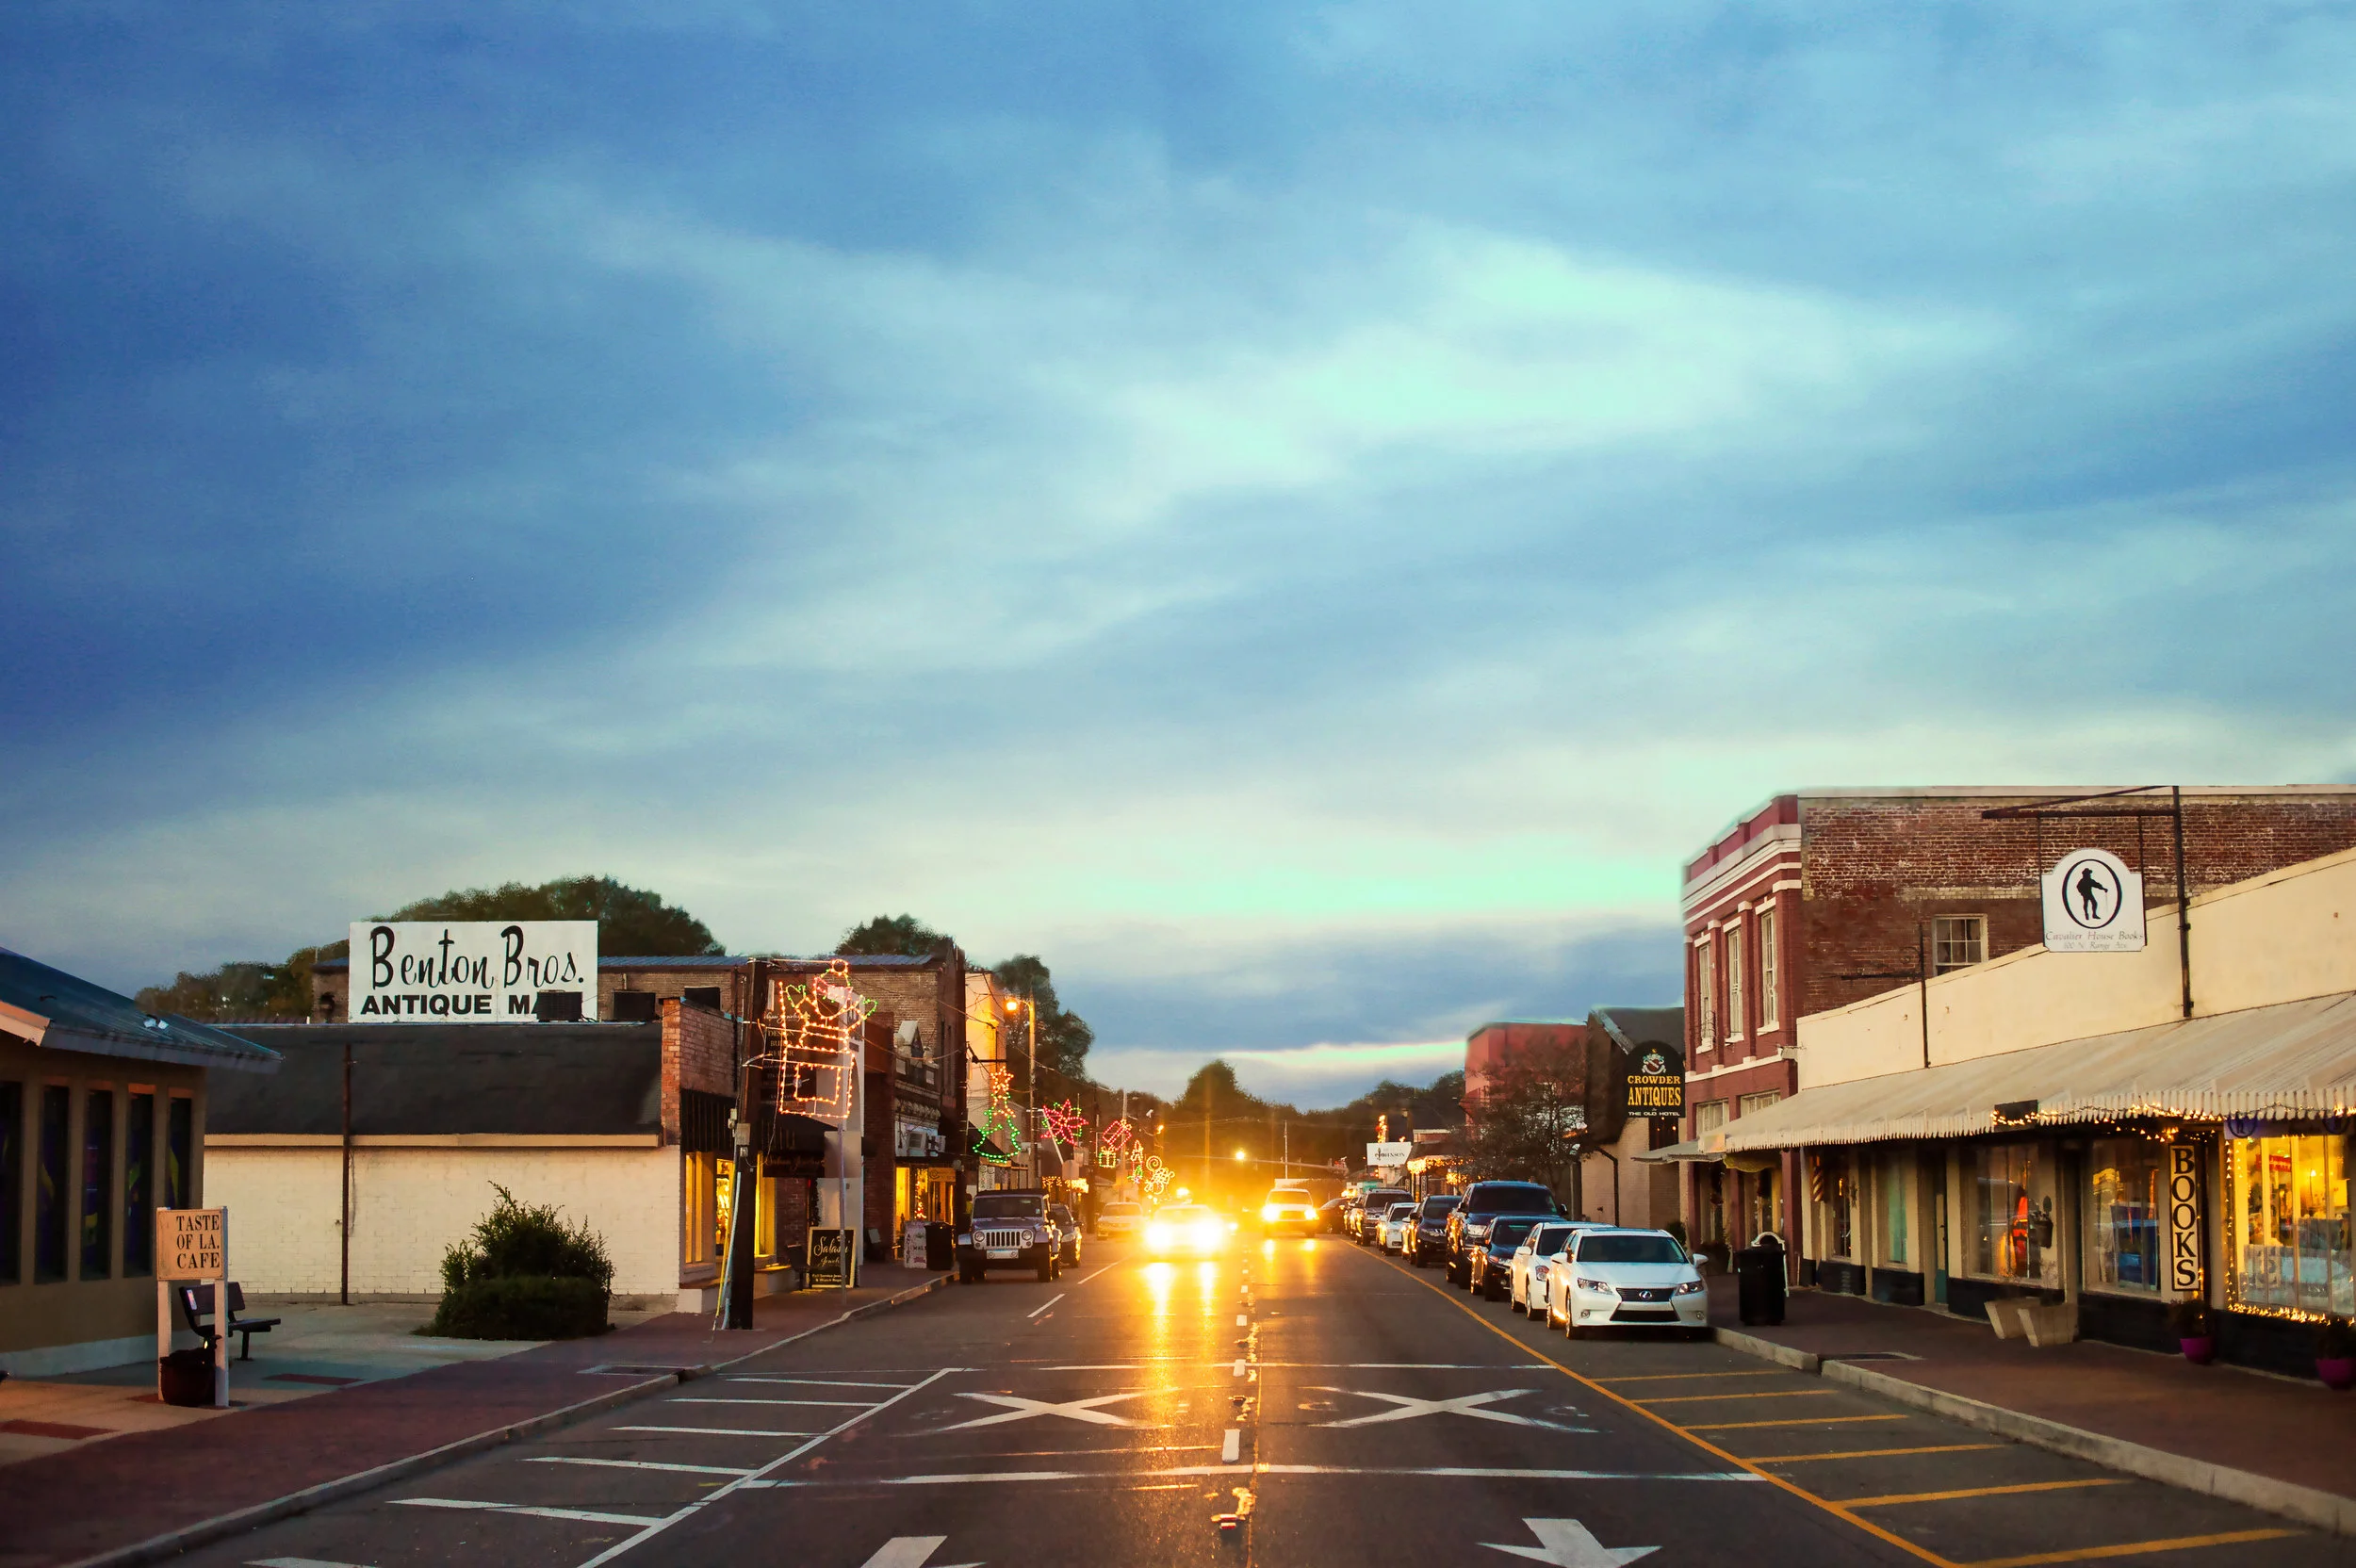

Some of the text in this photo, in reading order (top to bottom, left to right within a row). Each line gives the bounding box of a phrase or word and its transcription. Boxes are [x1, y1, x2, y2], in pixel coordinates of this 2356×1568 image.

[2045, 930, 2144, 940] Cavalier House Books
[369, 925, 584, 989] Benton Bros.
[361, 994, 492, 1017] ANTIQUE
[1628, 1075, 1681, 1085] CROWDER
[1628, 1086, 1681, 1106] ANTIQUES
[176, 1215, 220, 1231] TASTE
[2171, 1148, 2196, 1286] BOOKS
[176, 1233, 220, 1250] OF LA.
[176, 1252, 220, 1268] CAFE
